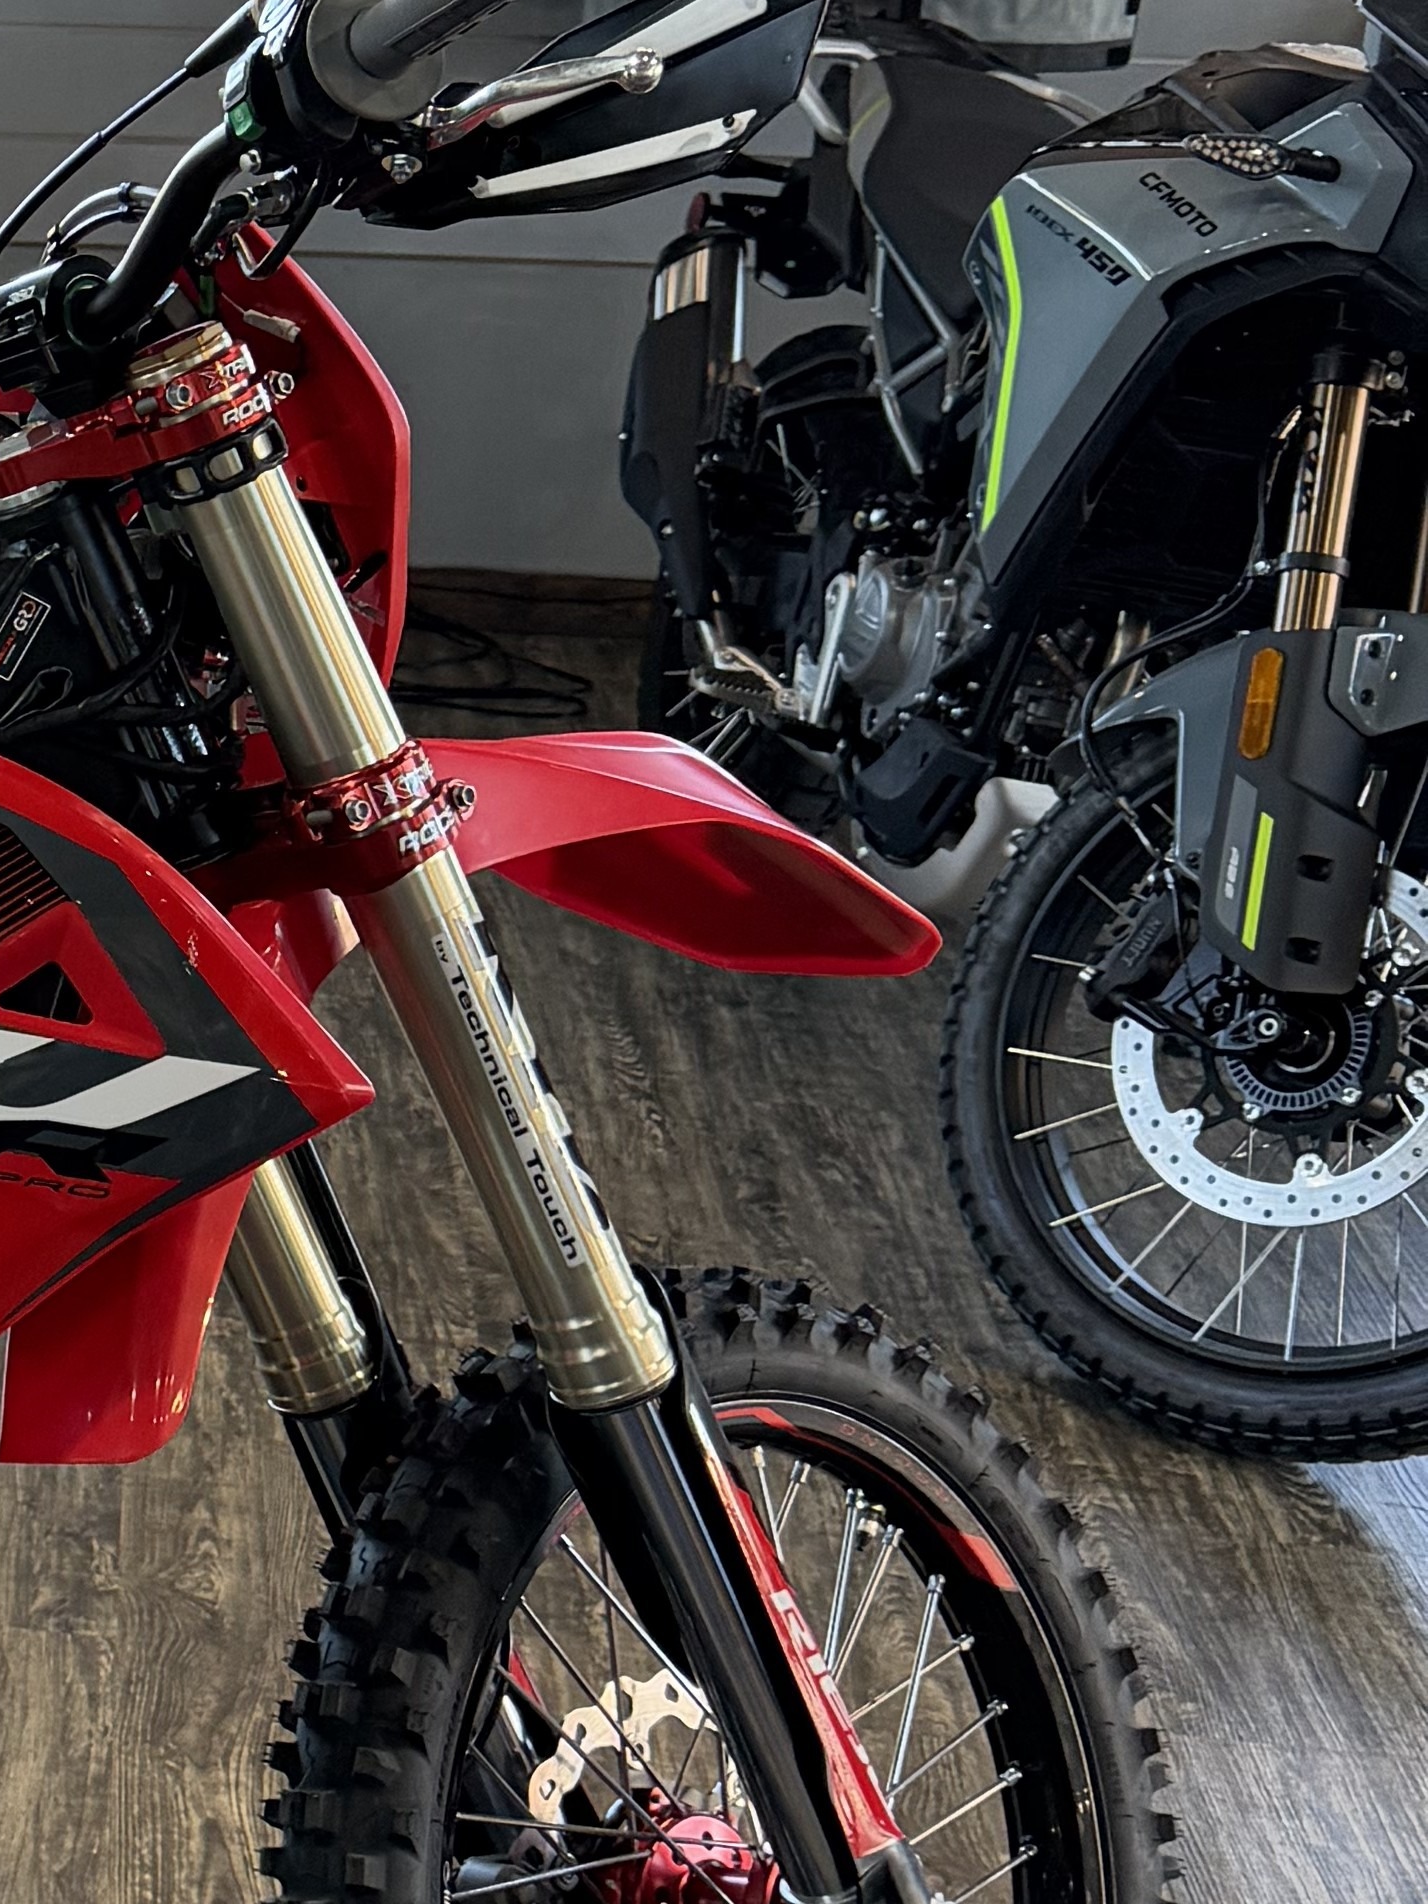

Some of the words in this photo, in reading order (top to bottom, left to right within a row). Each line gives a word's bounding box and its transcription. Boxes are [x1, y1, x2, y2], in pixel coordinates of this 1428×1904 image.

[1138, 171, 1218, 238] CFMOTO
[1075, 236, 1132, 287] 450
[435, 939, 449, 964] by
[451, 964, 529, 1138] Technical
[526, 1148, 578, 1262] Touch
